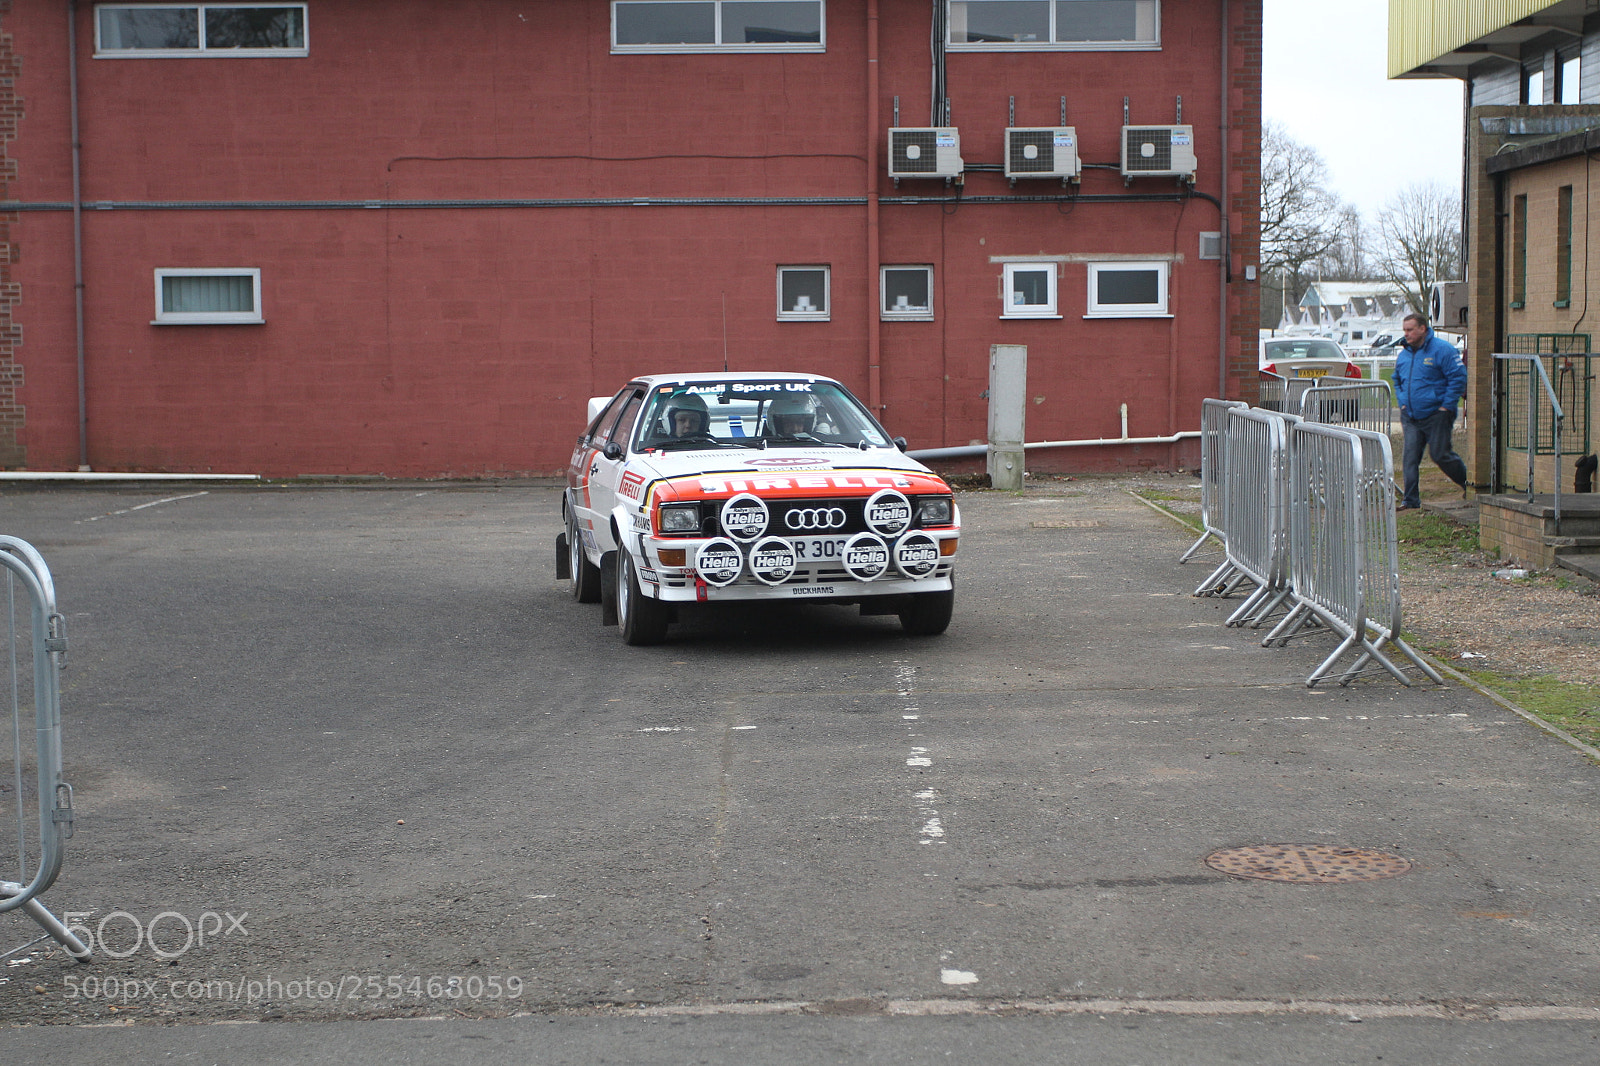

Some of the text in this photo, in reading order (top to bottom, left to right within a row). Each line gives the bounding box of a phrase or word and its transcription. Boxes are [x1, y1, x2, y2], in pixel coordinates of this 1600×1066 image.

[685, 383, 812, 395] Audi Sport UK
[618, 470, 646, 501] PIRELLI
[698, 474, 911, 493] PIRELLI
[728, 513, 764, 524] Hella
[872, 508, 907, 520] Hella
[849, 552, 885, 563] Hella
[901, 549, 936, 560] Hella
[702, 556, 738, 568] Hella
[756, 556, 792, 567] Hella
[792, 586, 834, 595] DUCKHAMS
